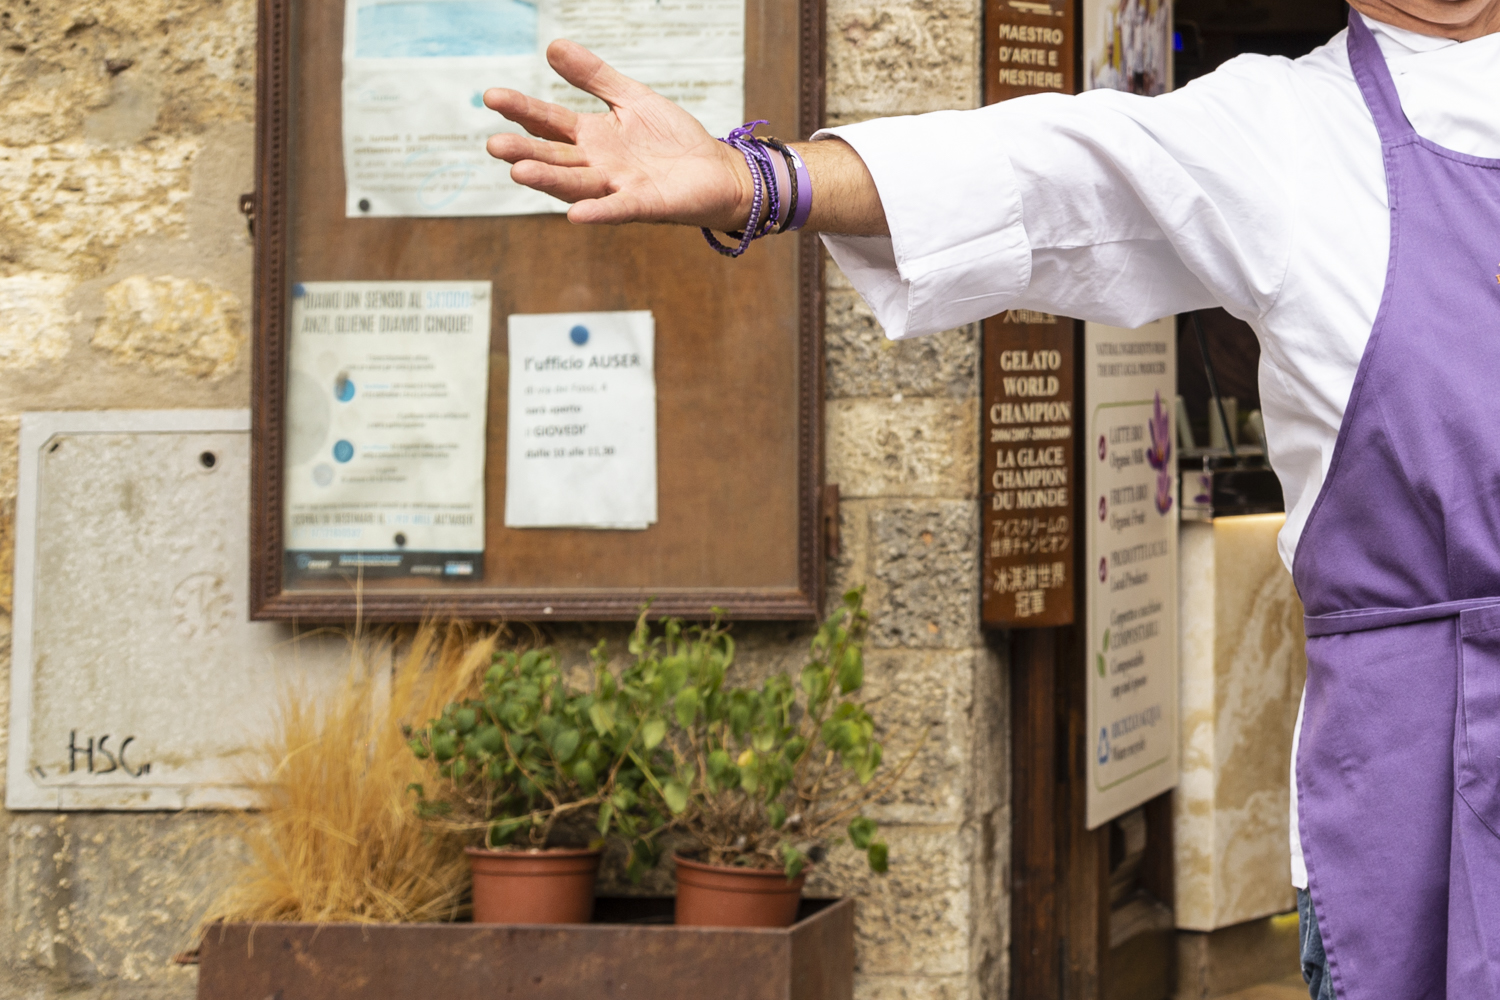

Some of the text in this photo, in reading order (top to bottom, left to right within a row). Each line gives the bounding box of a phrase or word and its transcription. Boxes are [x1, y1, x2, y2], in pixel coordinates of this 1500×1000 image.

[999, 24, 1064, 45] MAESTRO
[999, 46, 1059, 67] D'ARTE E
[999, 68, 1064, 89] MESTIERE
[524, 352, 641, 372] l'ufficio AUSER
[1000, 350, 1061, 371] GELATO
[1003, 375, 1059, 397] WORLD
[990, 401, 1071, 424] CHAMPION
[996, 446, 1065, 468] LA GLACE
[992, 467, 1067, 489] CHAMPION
[993, 487, 1068, 511] DU MONDE
